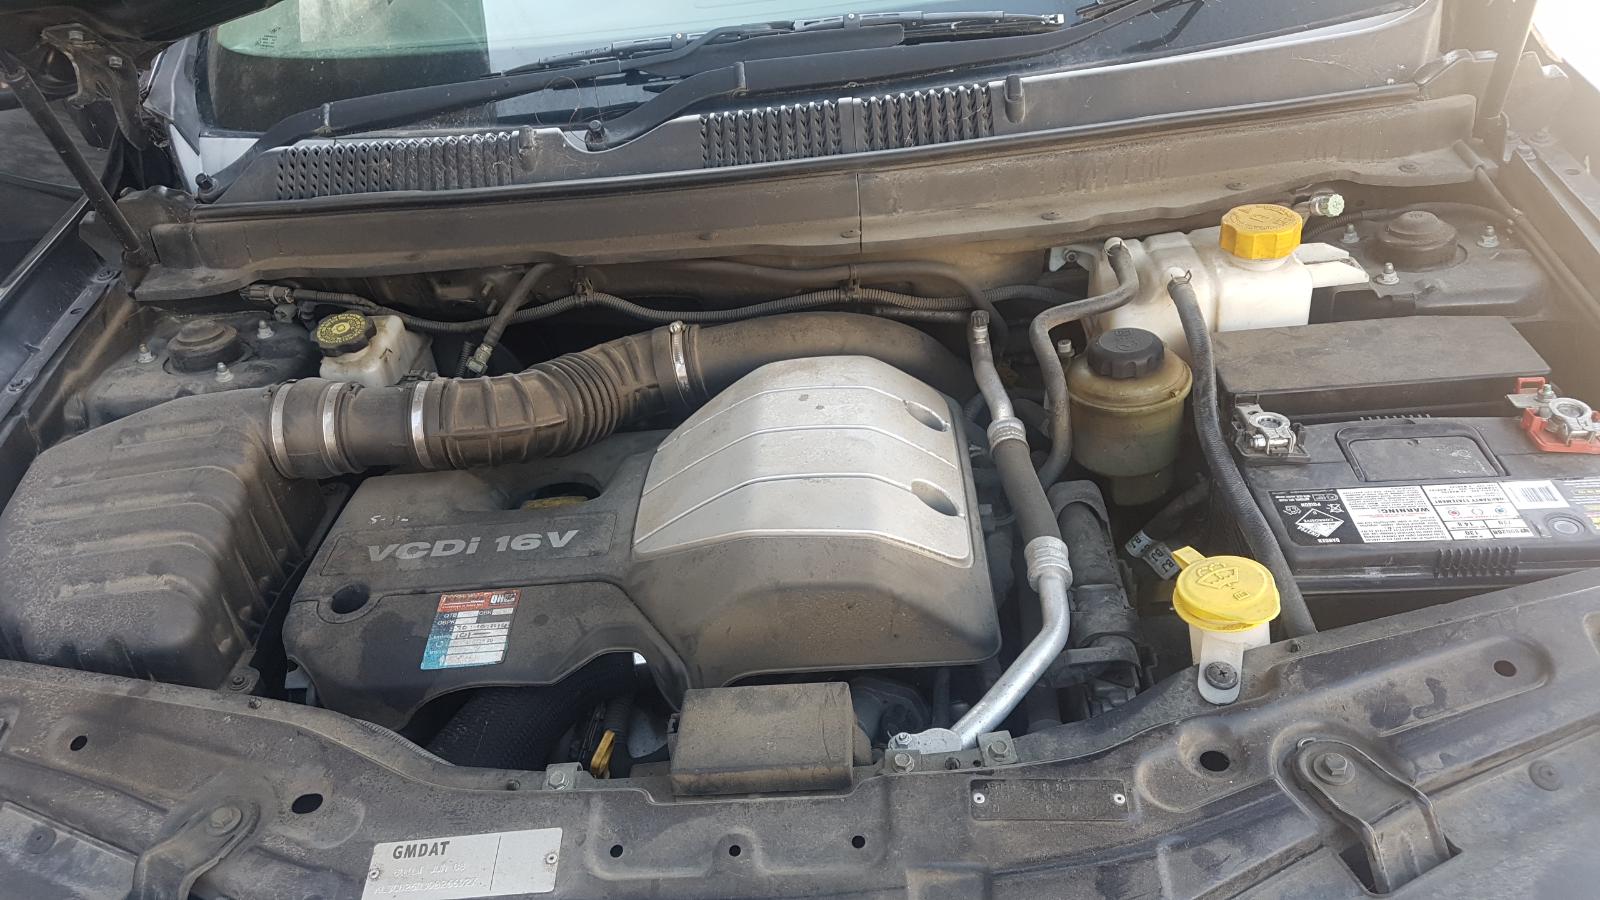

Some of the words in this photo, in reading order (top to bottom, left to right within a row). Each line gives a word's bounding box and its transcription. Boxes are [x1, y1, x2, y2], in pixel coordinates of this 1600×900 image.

[367, 536, 481, 562] VCDi
[495, 529, 579, 552] 16V
[392, 840, 450, 860] GMDAT
